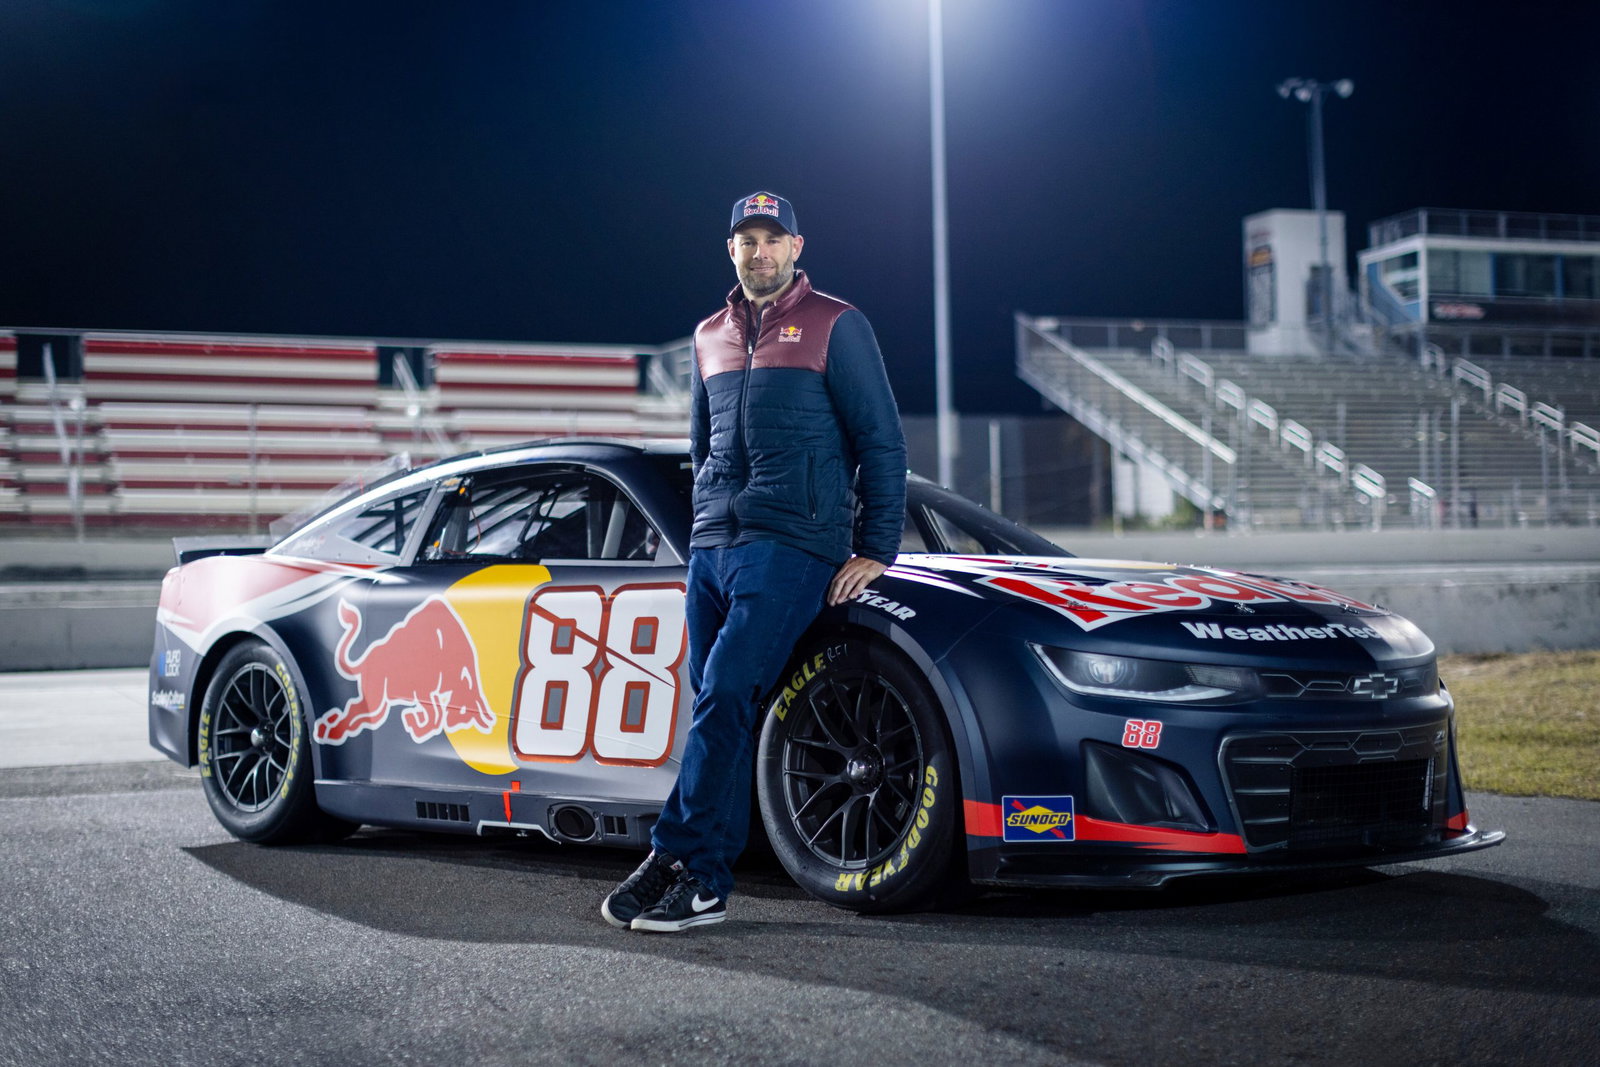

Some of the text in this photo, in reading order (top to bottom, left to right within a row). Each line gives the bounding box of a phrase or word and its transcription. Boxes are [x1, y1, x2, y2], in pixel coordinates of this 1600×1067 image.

[743, 206, 779, 218] Red Bull
[974, 573, 1290, 631] Red
[165, 663, 180, 677] LOCK
[512, 582, 687, 768] 88
[773, 652, 826, 721] EAGLE
[199, 712, 212, 777] EAGLE
[1122, 718, 1163, 749] 88
[834, 765, 939, 892] GOODYEAR
[1009, 813, 1069, 826] SUNOCO
